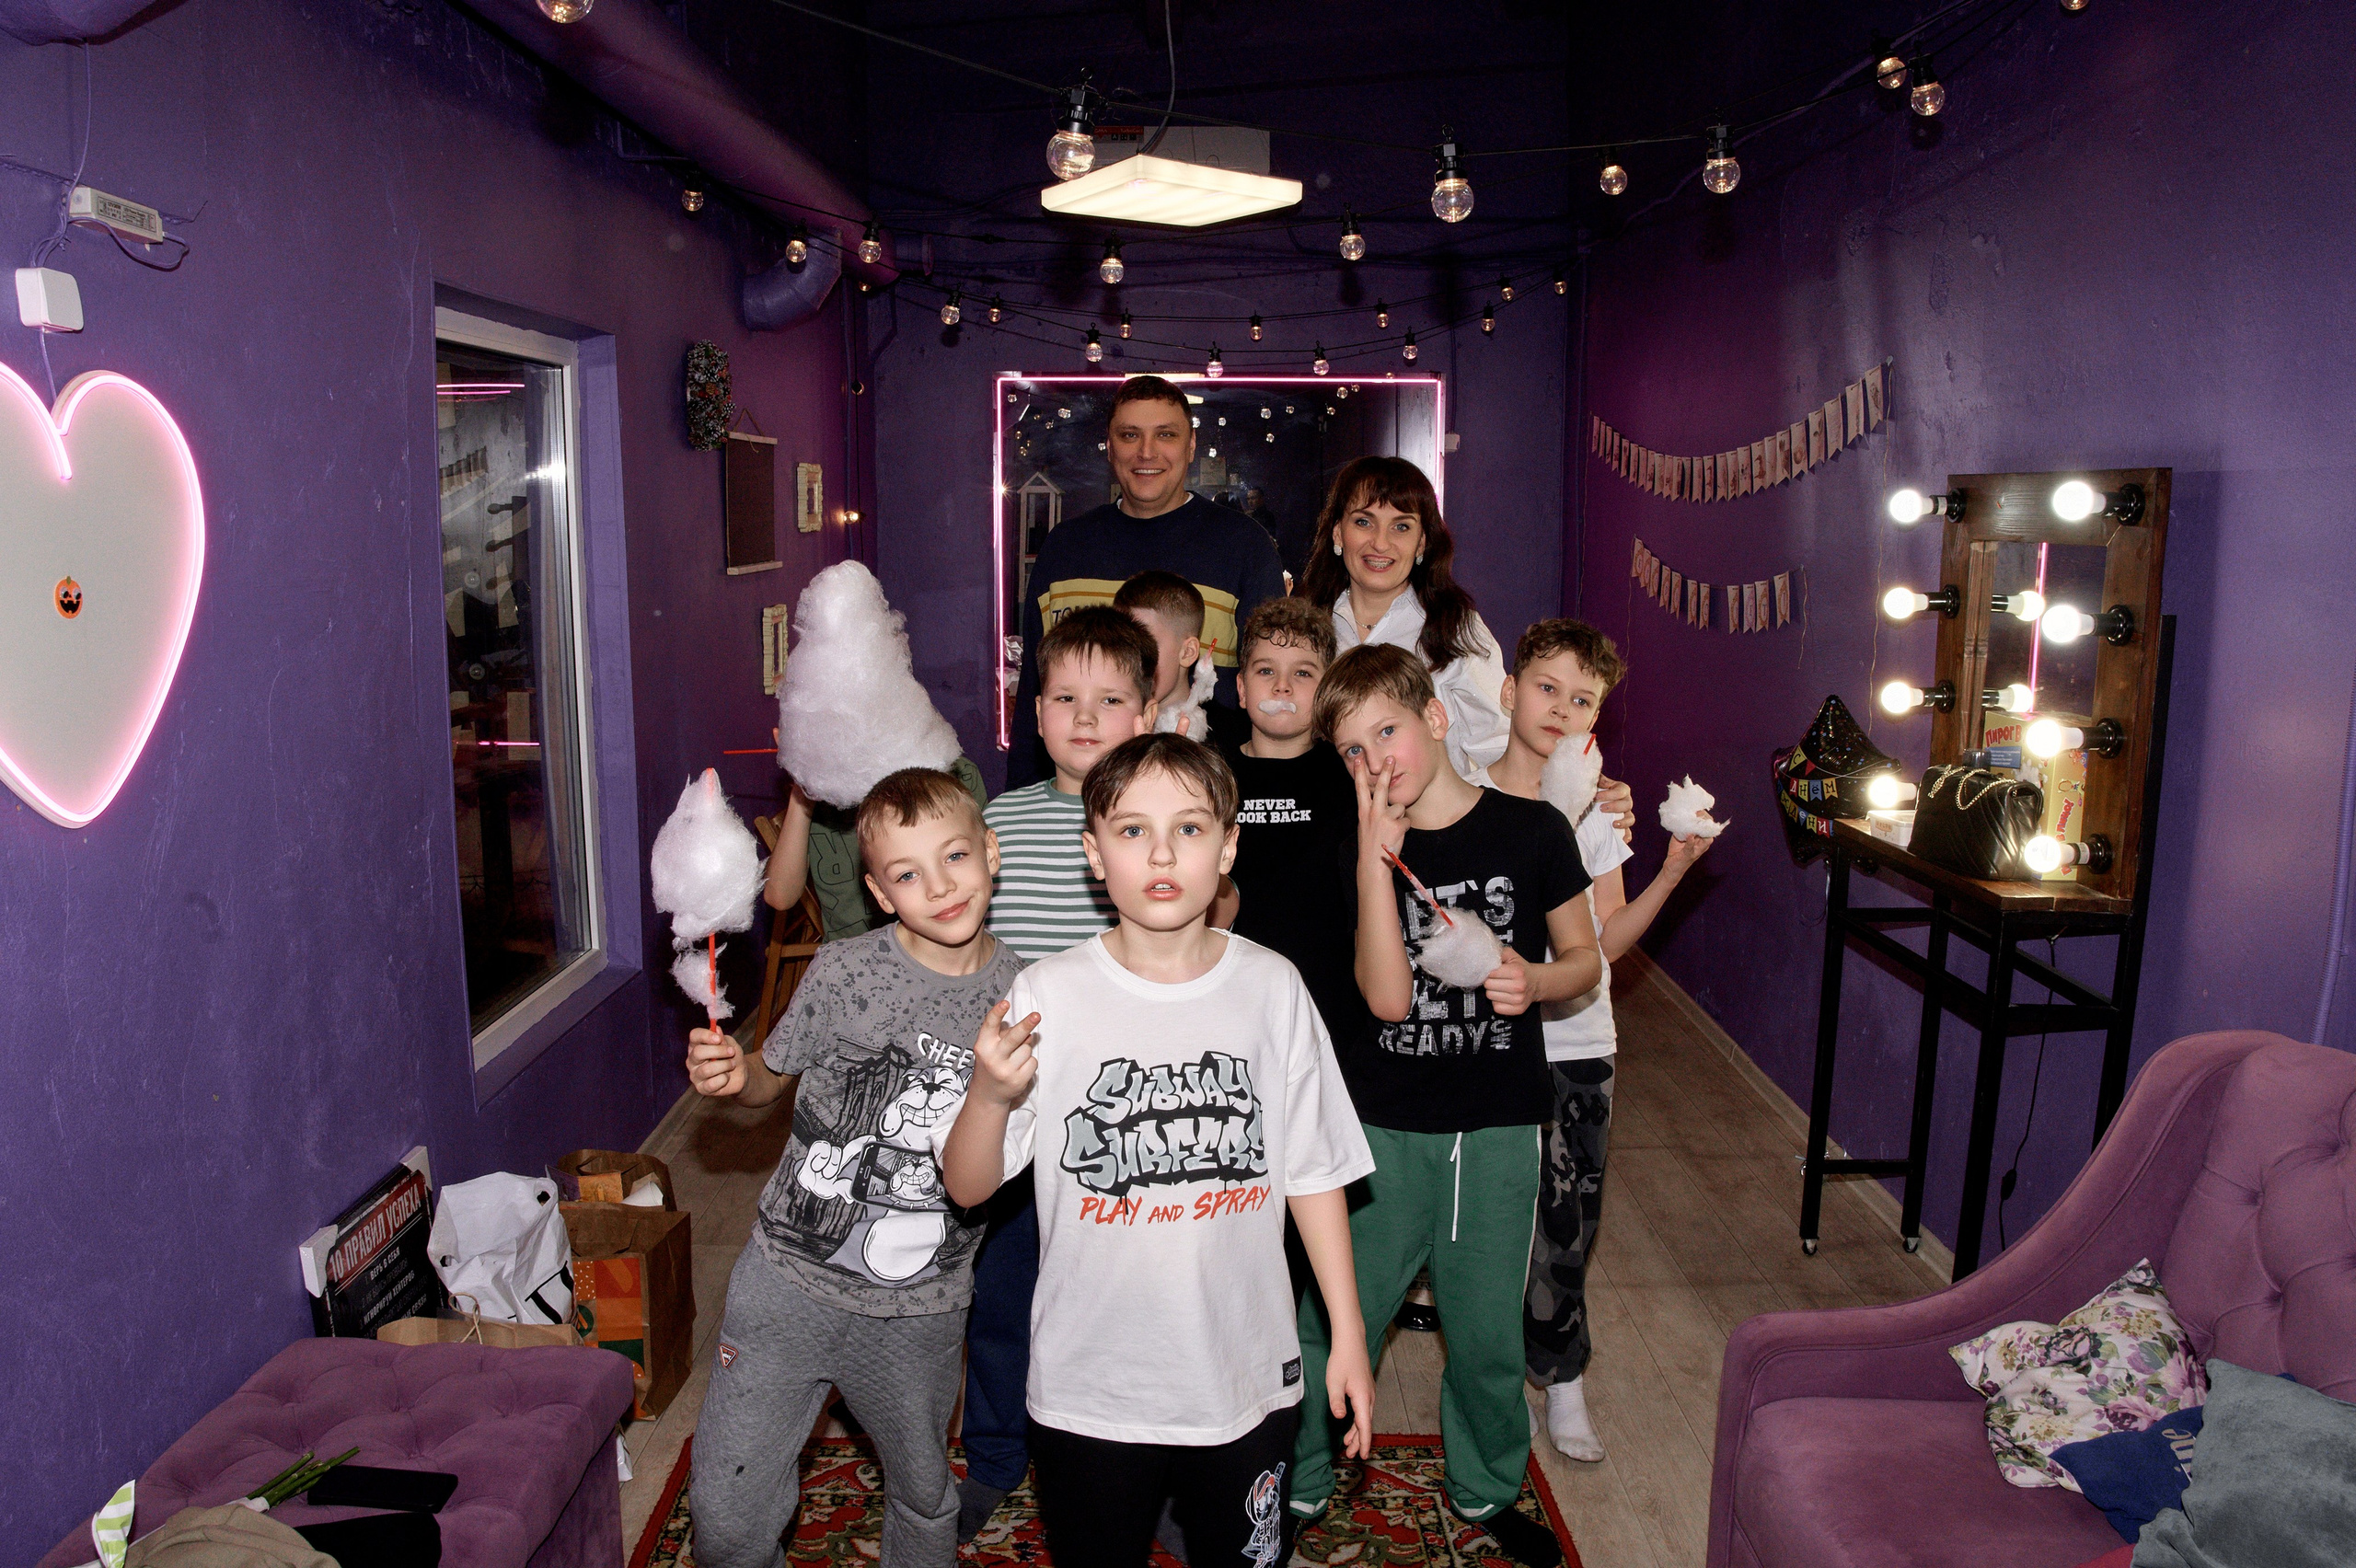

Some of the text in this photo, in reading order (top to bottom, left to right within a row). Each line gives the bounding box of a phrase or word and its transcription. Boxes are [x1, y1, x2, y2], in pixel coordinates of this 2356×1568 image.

[1985, 725, 2015, 747] ПИРОГ
[1235, 810, 1311, 824] OOK BACK
[1243, 799, 1296, 811] NEVER
[918, 1032, 976, 1069] CHEE
[1379, 1020, 1488, 1056] READY
[1086, 1051, 1255, 1124] SUBWAY
[1080, 1184, 1271, 1227] PLAY AND SPRAY
[329, 1183, 422, 1283] 10 ПРАВИЛ УСПЕХА
[370, 1262, 384, 1281] ВЕРЬ
[387, 1246, 400, 1264] СЕБЯ
[364, 1288, 393, 1326] ИГНОРИРУЙ
[392, 1269, 416, 1297] ХЕЙТЕРОВ
